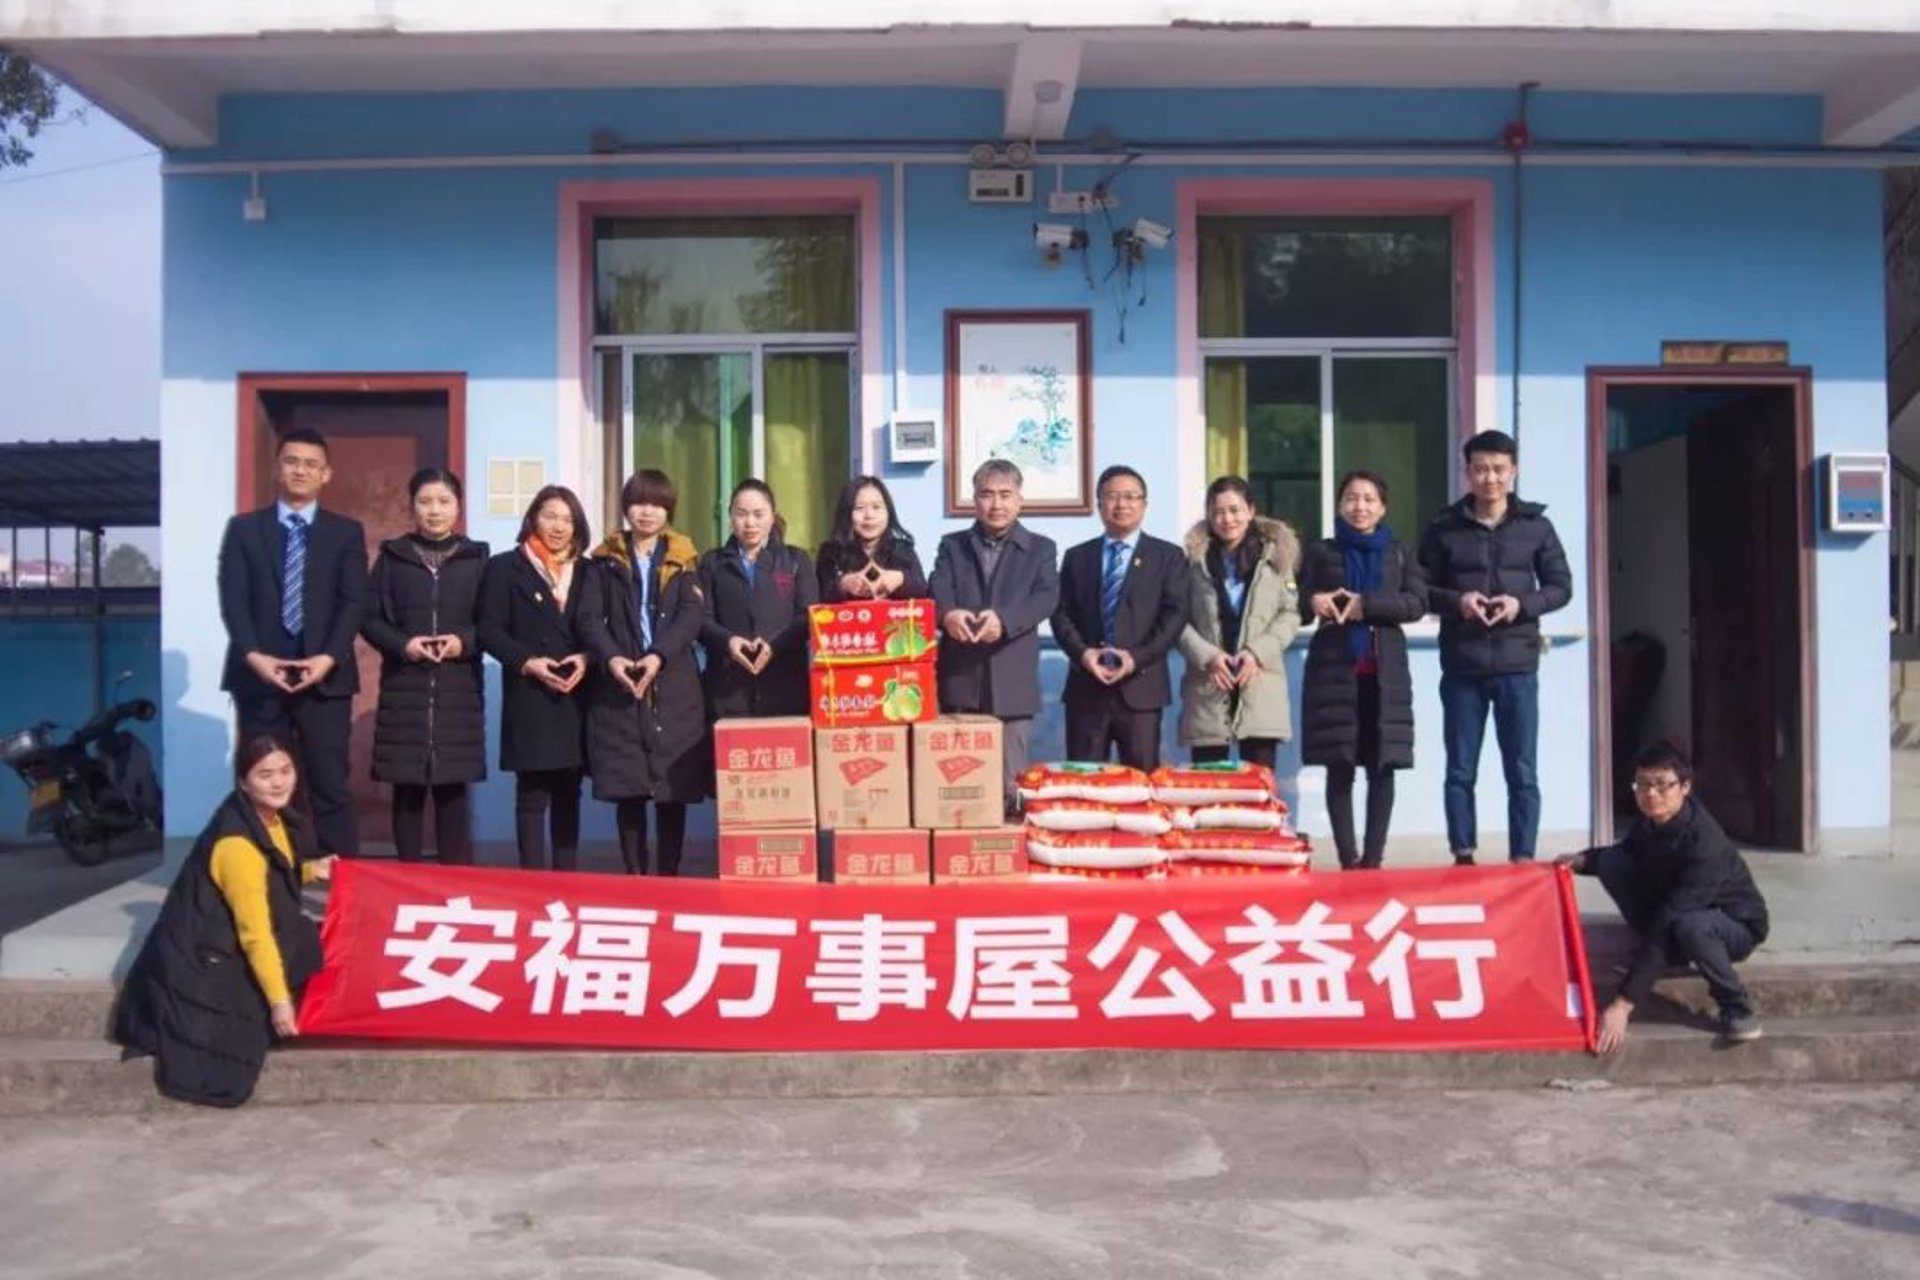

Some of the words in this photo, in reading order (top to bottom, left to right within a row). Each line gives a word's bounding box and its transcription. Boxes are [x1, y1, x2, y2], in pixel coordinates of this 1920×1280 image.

[376, 896, 1497, 1022] 安福万事屋公益行
